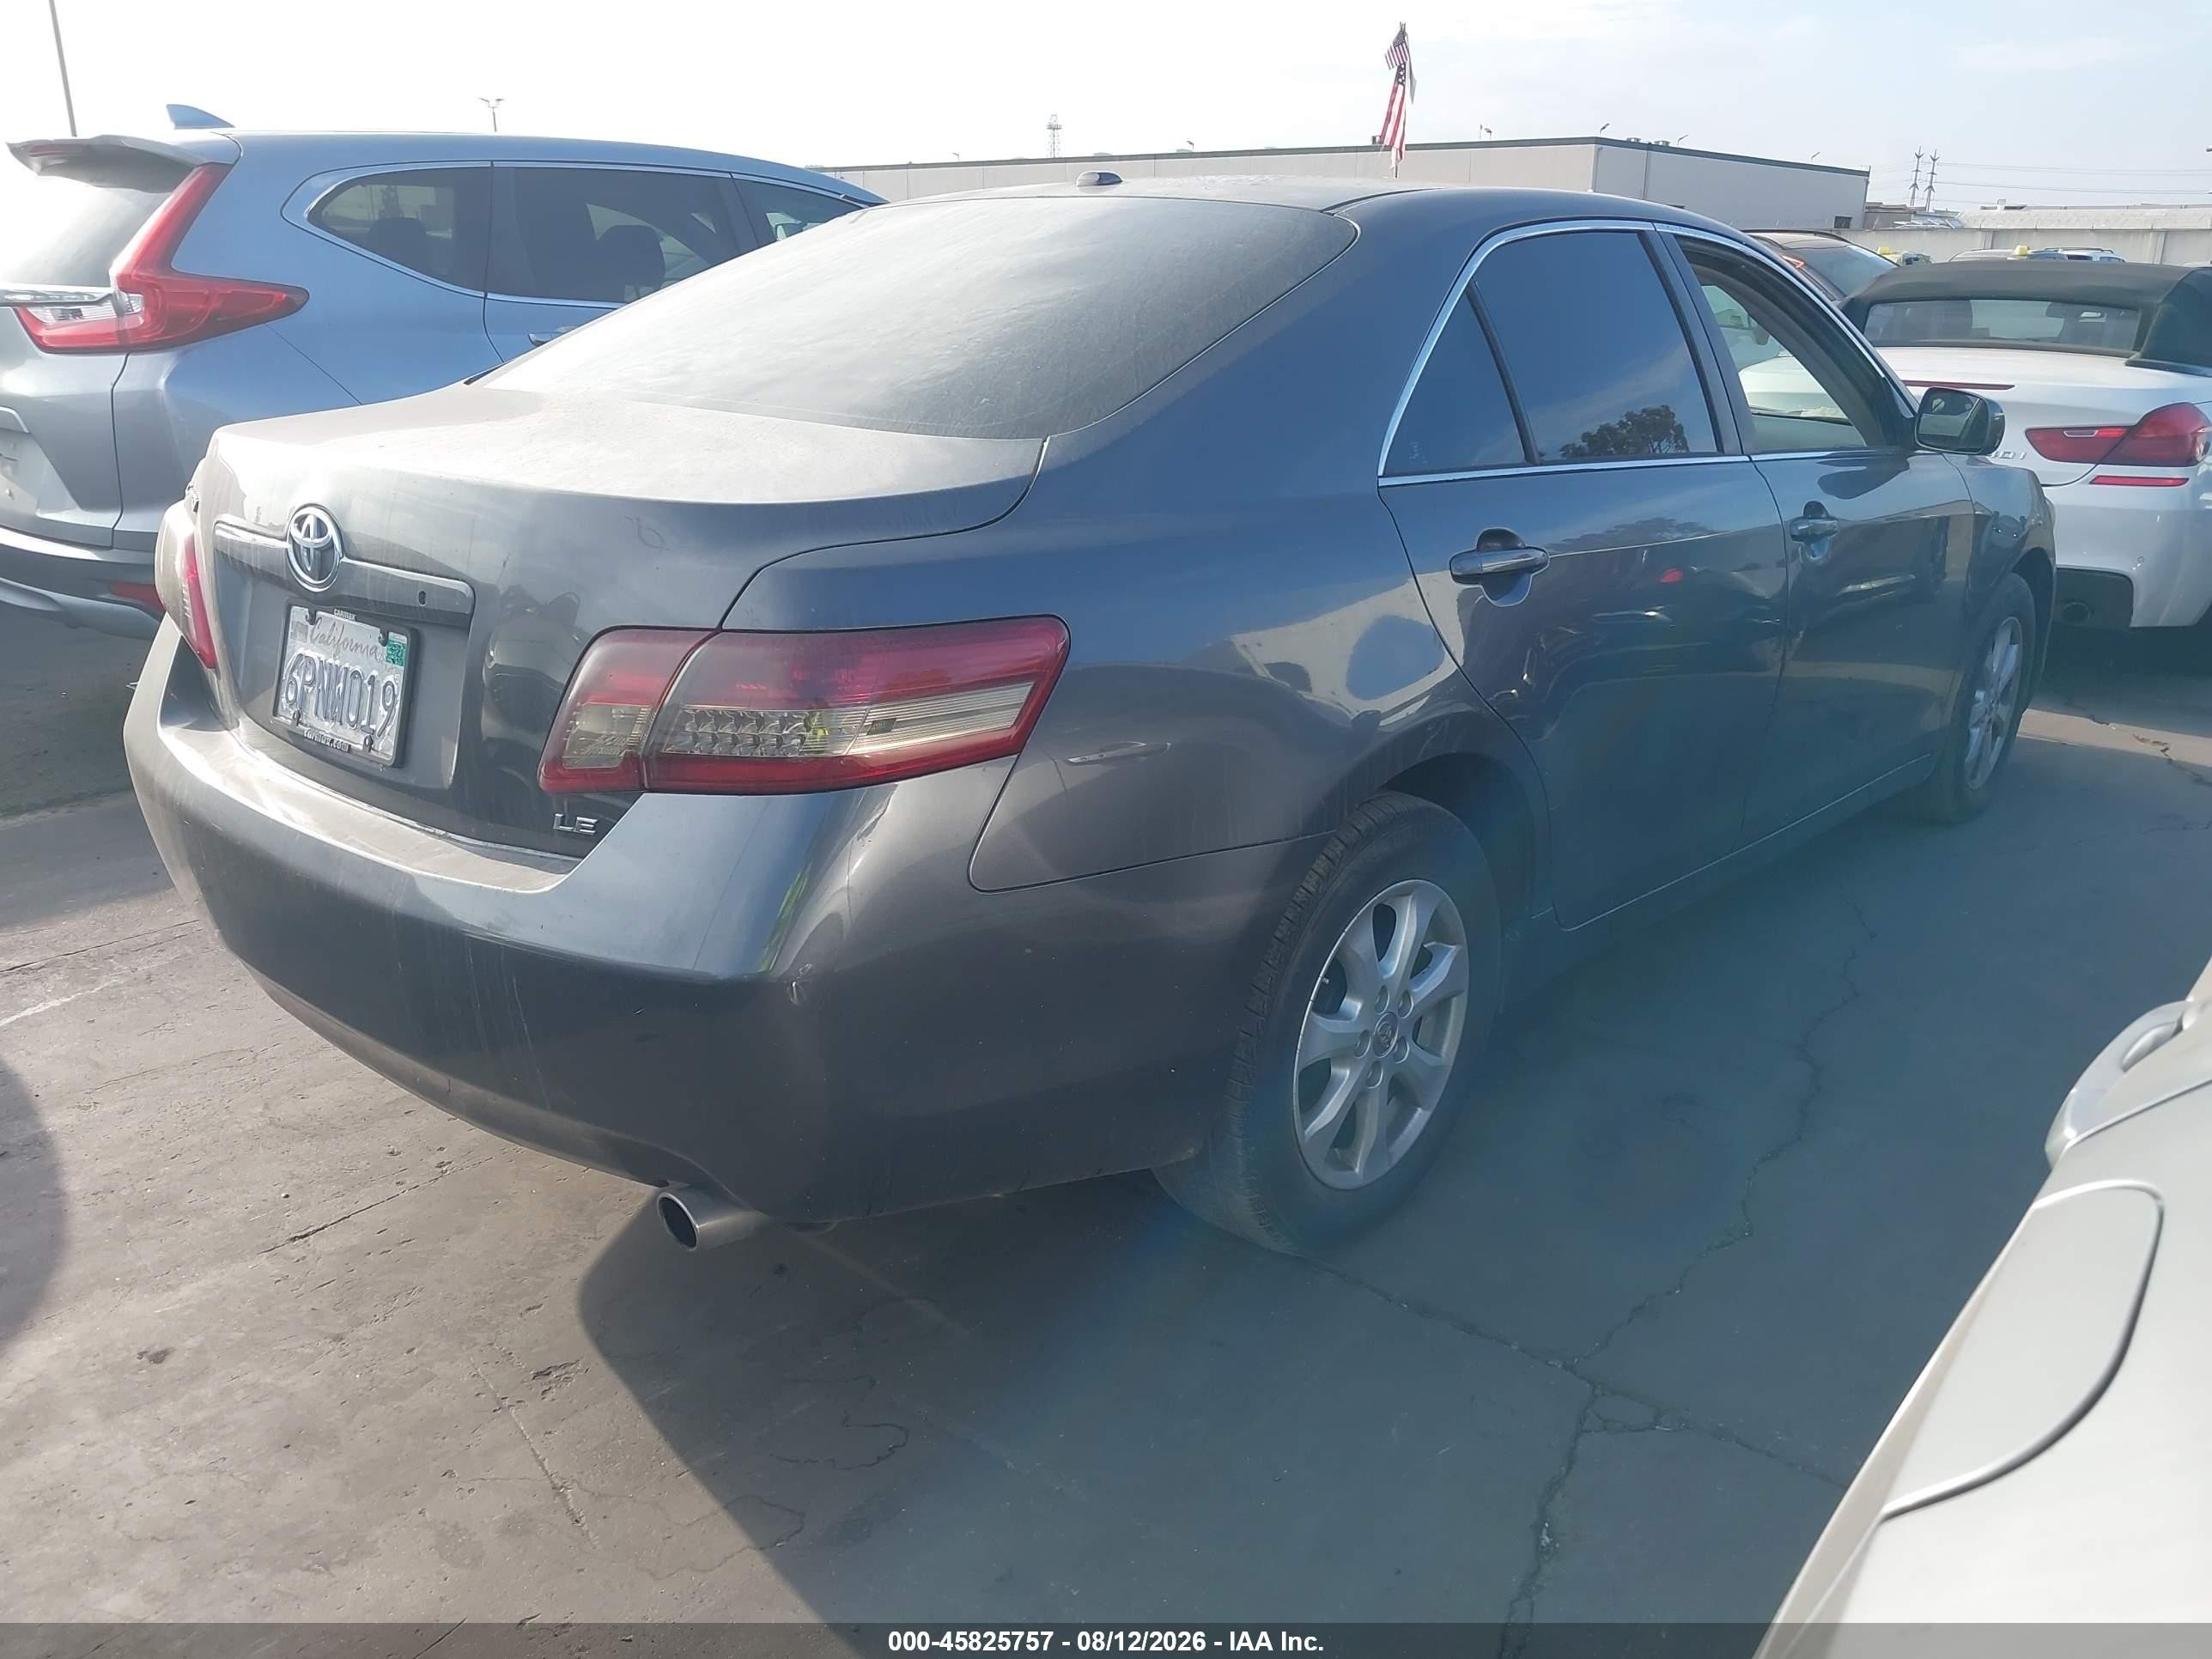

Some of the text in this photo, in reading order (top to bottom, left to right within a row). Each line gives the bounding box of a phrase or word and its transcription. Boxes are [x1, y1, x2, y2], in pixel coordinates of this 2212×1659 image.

[310, 617, 379, 660] California
[285, 653, 397, 738] 6PNW019
[553, 813, 598, 835] LE
